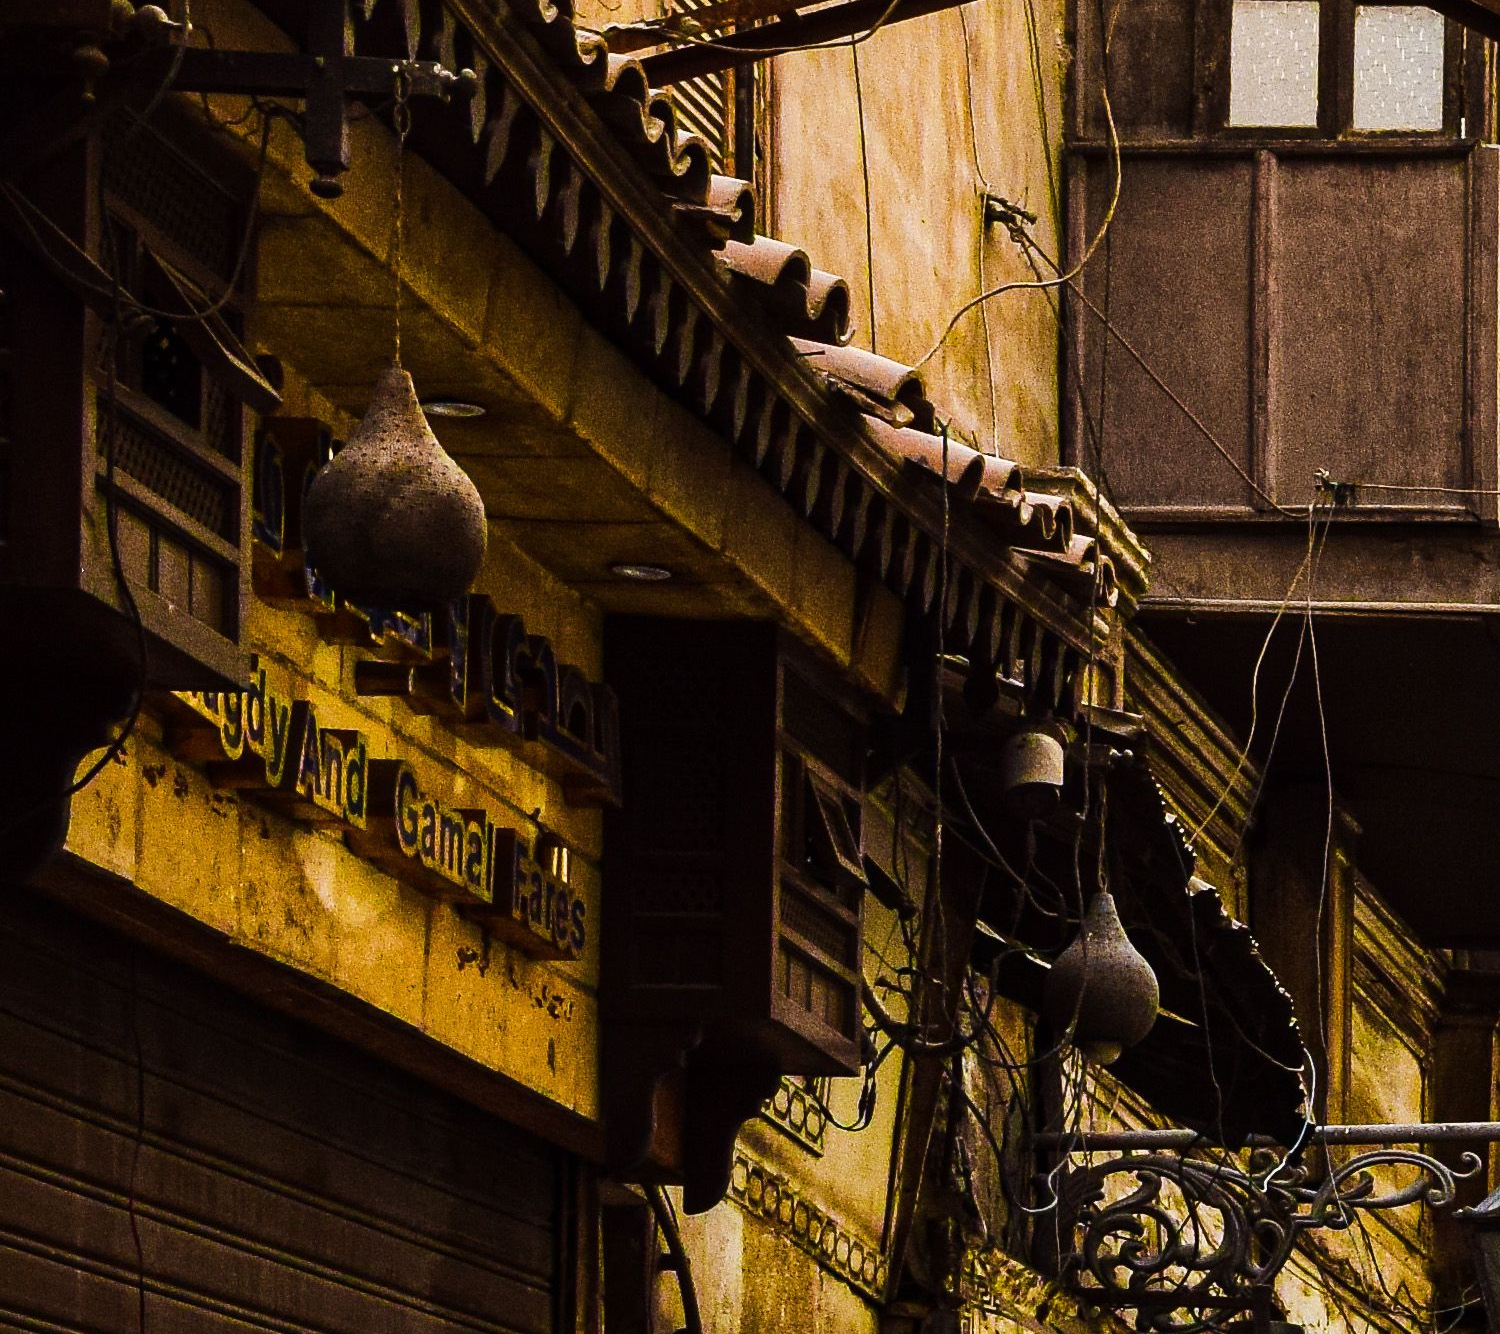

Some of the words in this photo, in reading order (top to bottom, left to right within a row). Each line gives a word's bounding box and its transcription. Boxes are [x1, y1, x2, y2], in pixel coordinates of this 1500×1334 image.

[301, 711, 367, 822] And
[397, 770, 495, 899] Gamal
[513, 841, 586, 953] Fares
